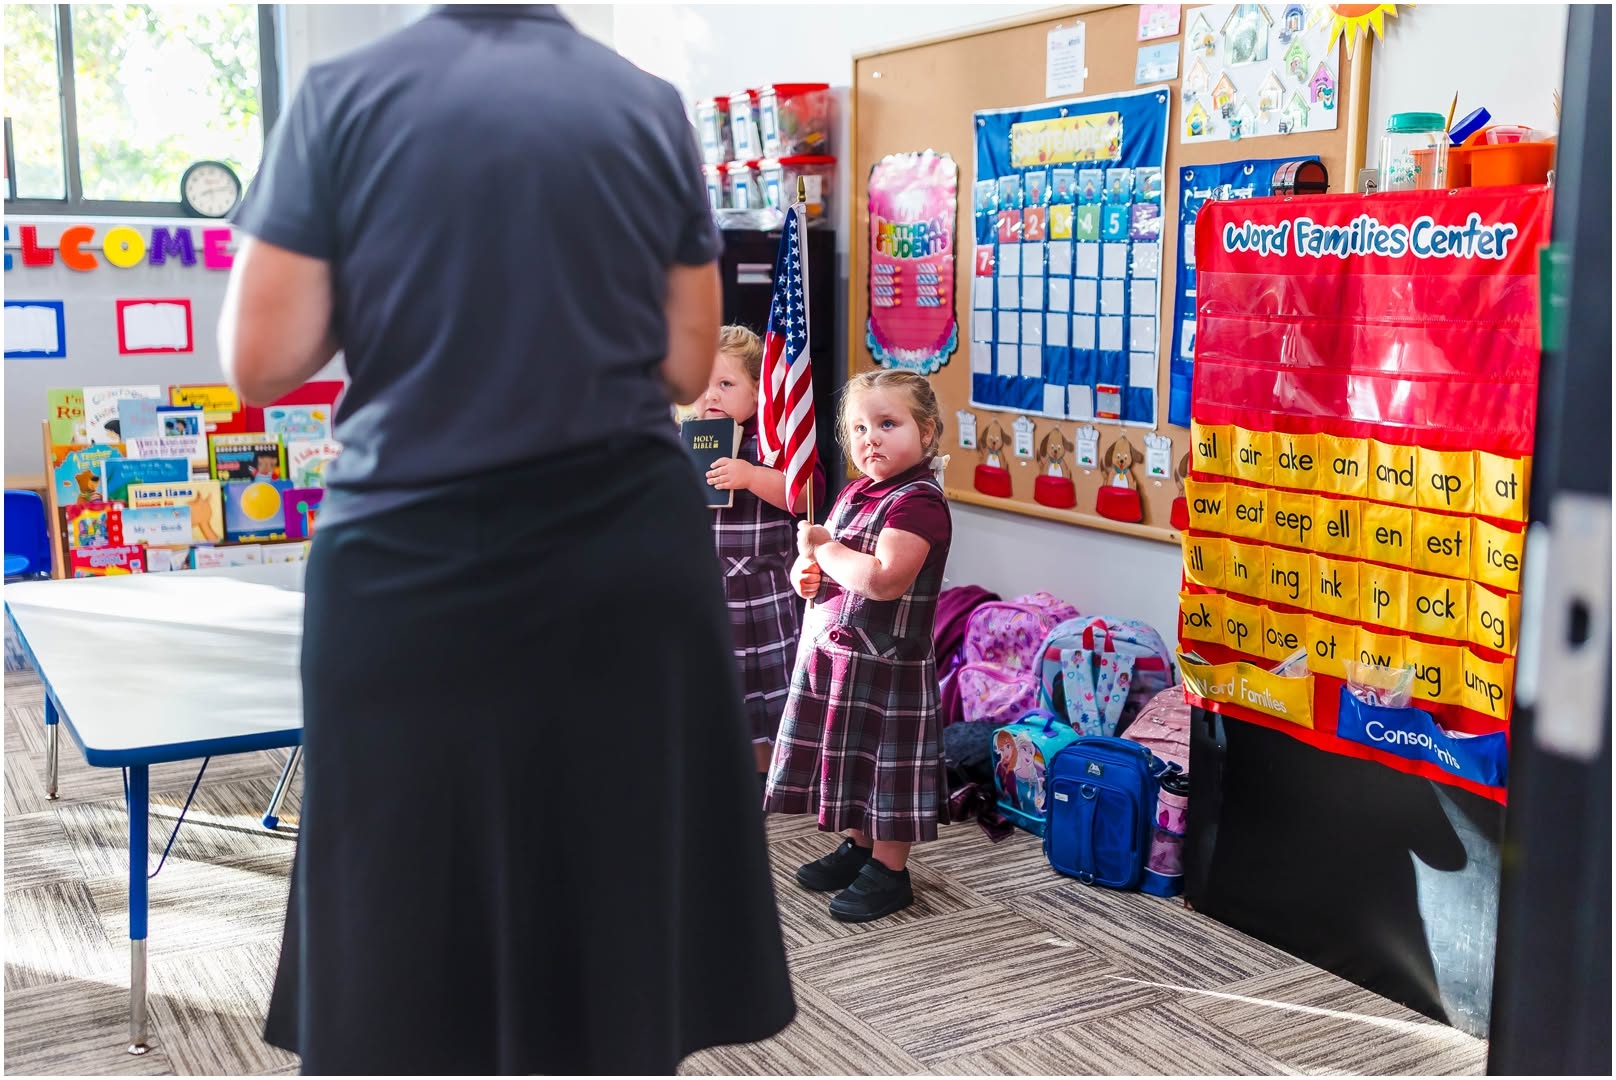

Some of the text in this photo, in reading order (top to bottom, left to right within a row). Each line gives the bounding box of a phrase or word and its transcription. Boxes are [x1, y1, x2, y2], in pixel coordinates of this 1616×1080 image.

[1028, 213, 1040, 236] 2
[1054, 212, 1066, 236] 3
[1078, 211, 1093, 235] 4
[1108, 212, 1121, 235] 5
[1224, 213, 1516, 258] Word Families Center
[876, 231, 949, 258] STUDENTS
[978, 251, 989, 273] 7
[693, 442, 713, 450] BIBLE
[1198, 432, 1518, 506] ail air ake an and ap at
[134, 487, 193, 498] llama llama
[1193, 498, 1519, 572] aw eat eep ell en est ice
[1189, 545, 1505, 649] ill in ing ink ip ock og
[1226, 618, 1249, 649] op
[1265, 627, 1299, 650] ose
[1315, 635, 1337, 660] ot
[1360, 649, 1392, 671] ow
[1414, 663, 1442, 698] ug
[1465, 670, 1504, 712] ump
[1240, 678, 1288, 713] Families
[1365, 720, 1461, 770] Consonts
